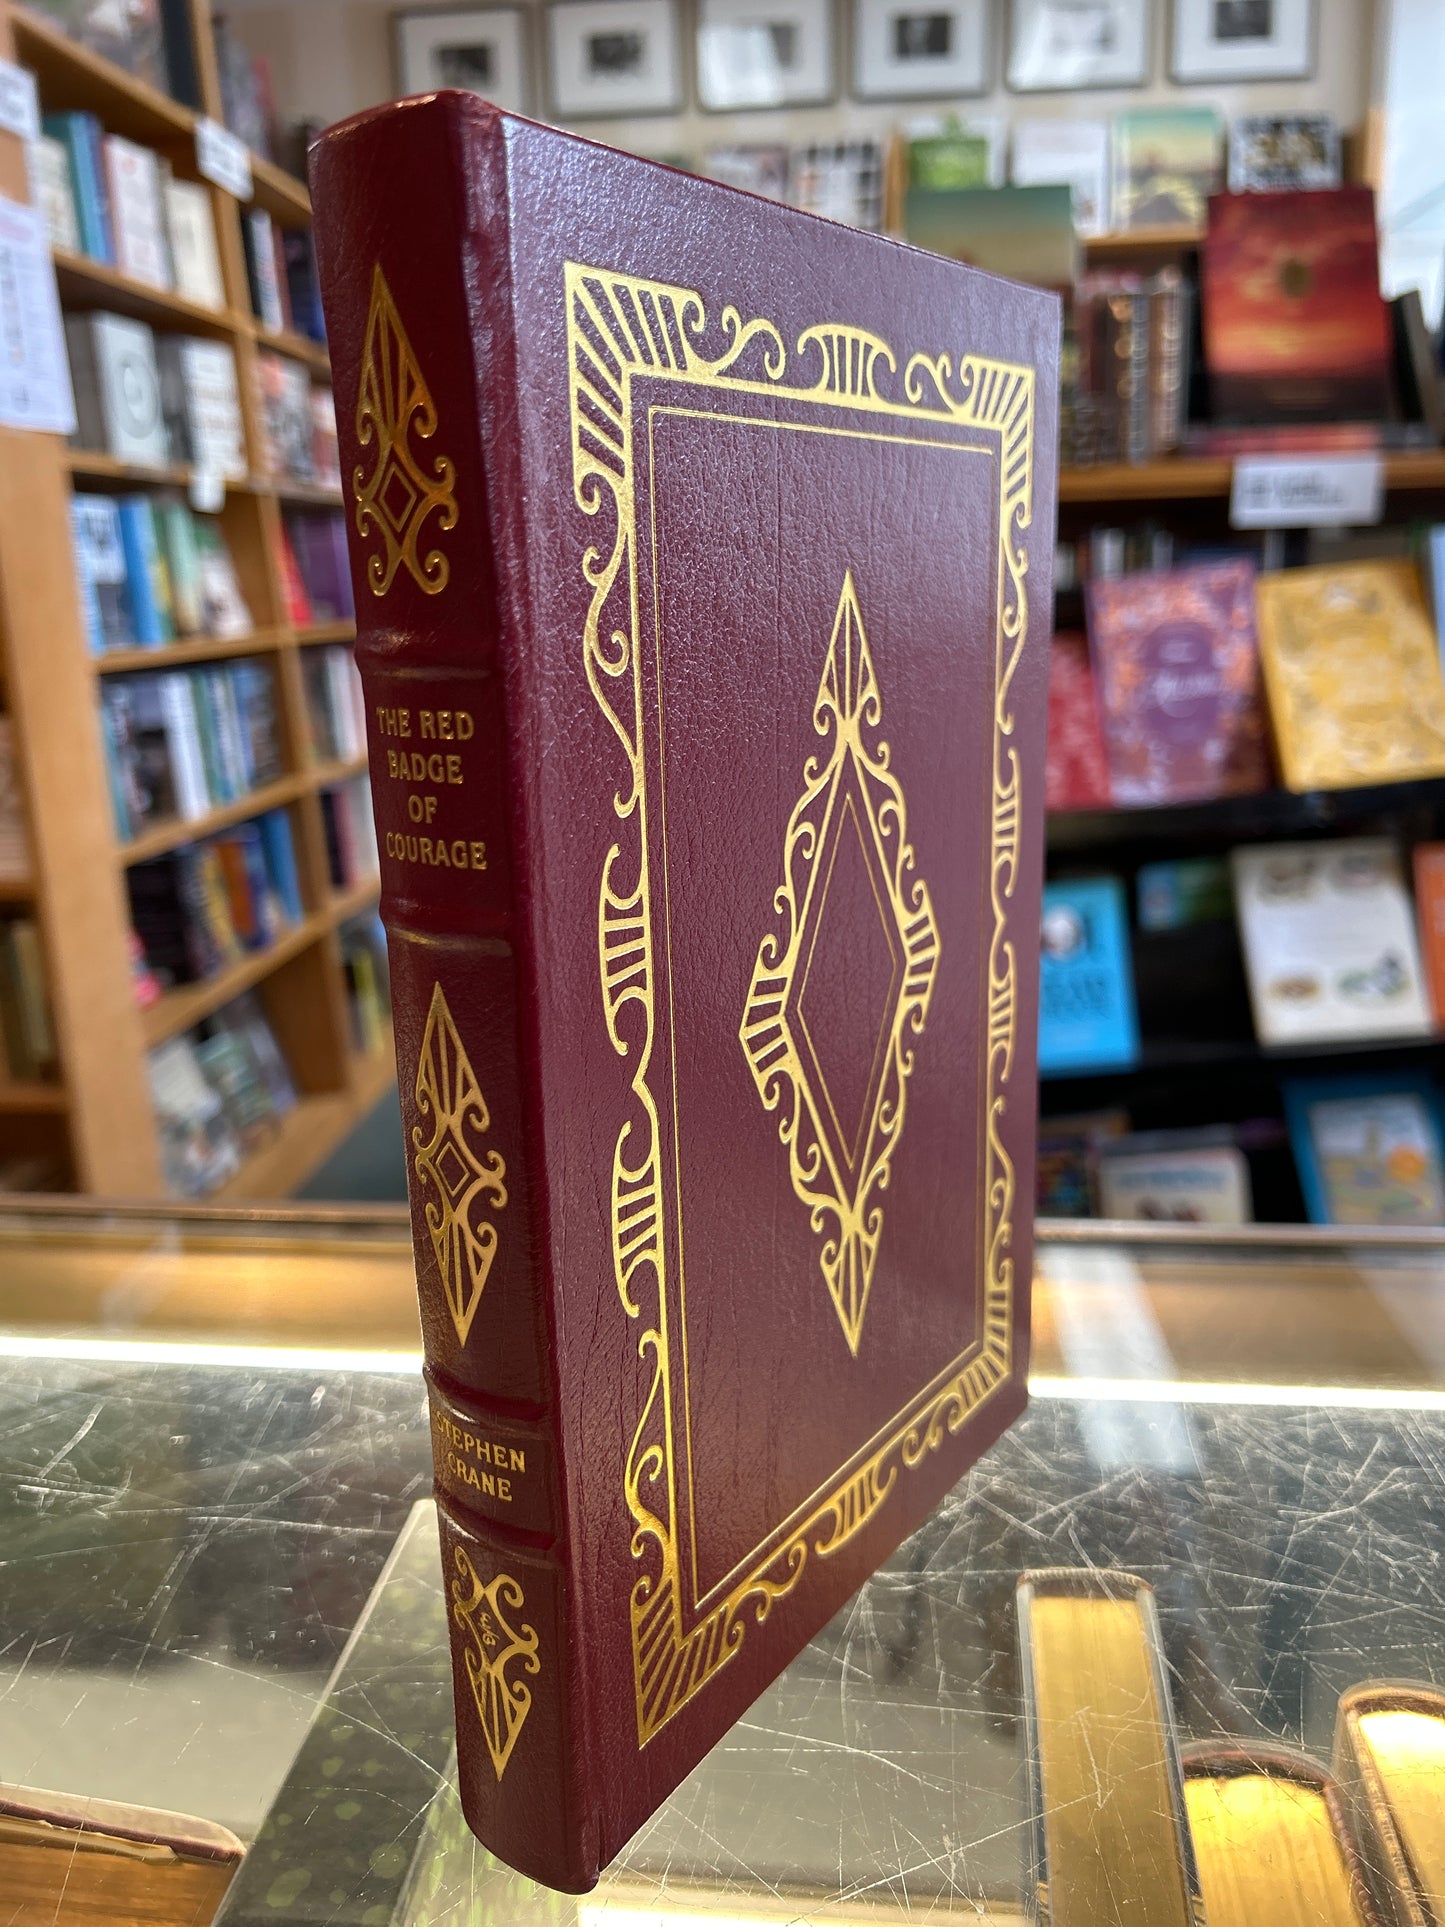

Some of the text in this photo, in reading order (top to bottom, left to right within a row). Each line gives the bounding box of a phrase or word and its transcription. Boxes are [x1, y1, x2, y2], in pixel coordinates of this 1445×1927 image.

[376, 706, 475, 740] THE RED
[387, 750, 464, 784] BADGE
[408, 795, 438, 824] OF
[386, 832, 488, 870] COURAGE
[436, 1410, 526, 1473] STEPHEN
[447, 1451, 513, 1501] CRANE
